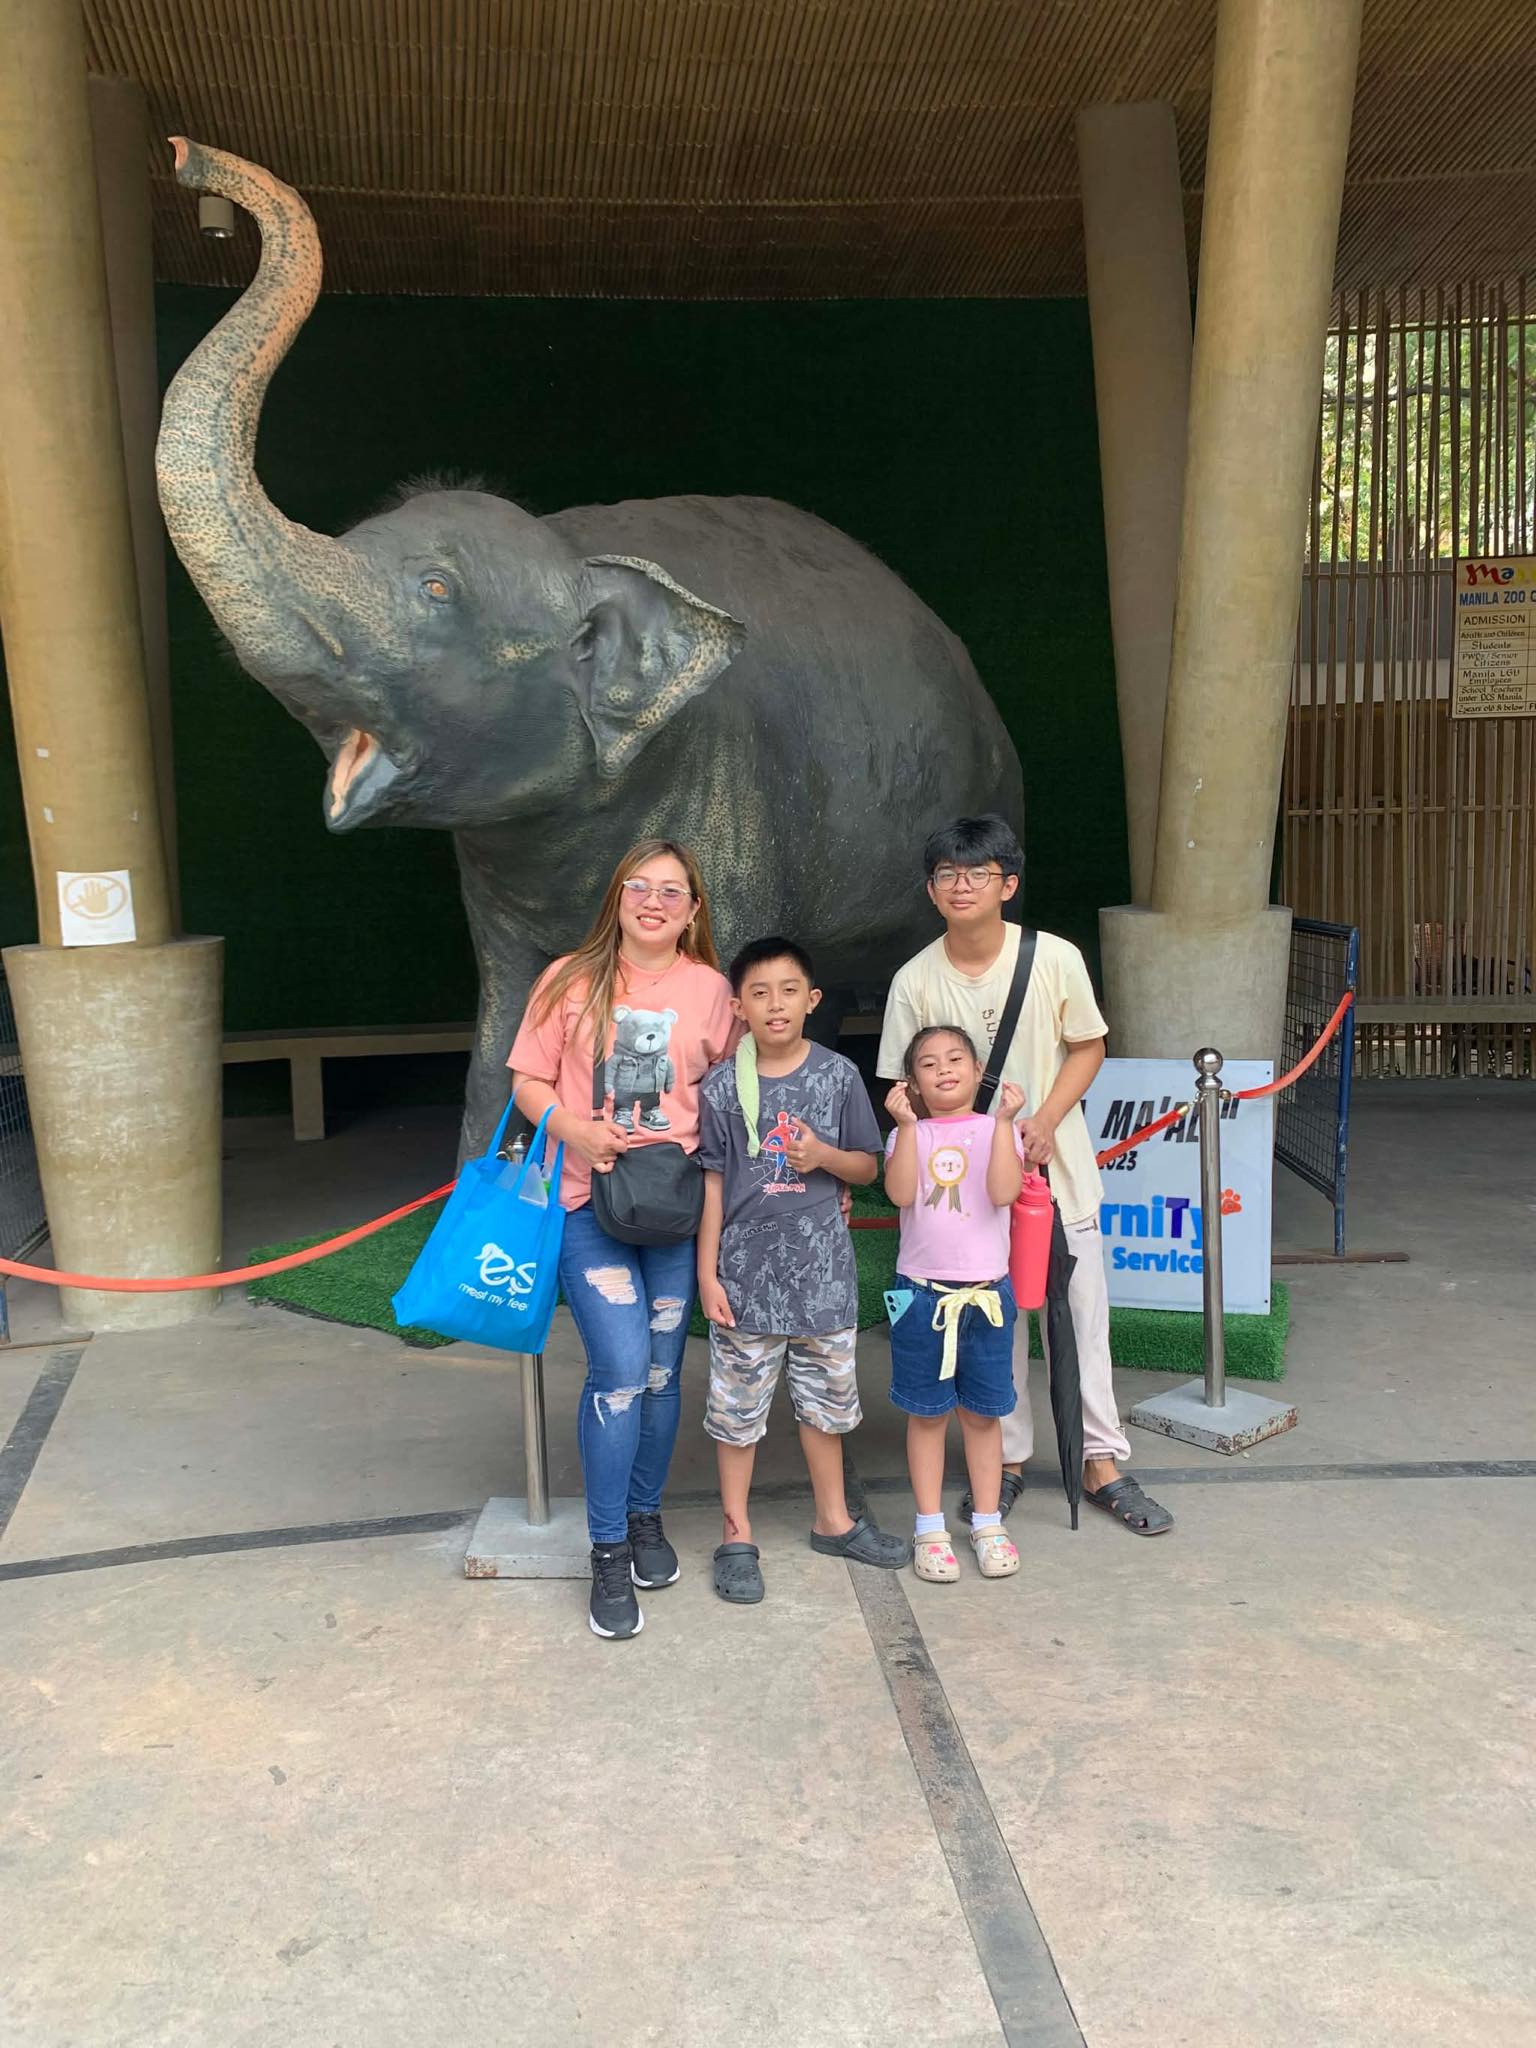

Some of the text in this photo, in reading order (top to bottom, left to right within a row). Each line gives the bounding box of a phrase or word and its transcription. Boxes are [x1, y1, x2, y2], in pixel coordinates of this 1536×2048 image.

[1459, 591, 1499, 606] MANILA
[1503, 590, 1526, 604] ZOO
[1463, 614, 1526, 625] ADMISSION
[1471, 640, 1511, 650] Students
[1463, 668, 1520, 678] Manila LGU
[1461, 686, 1486, 694] School
[1112, 1246, 1204, 1274] Service
[487, 1293, 507, 1306] my
